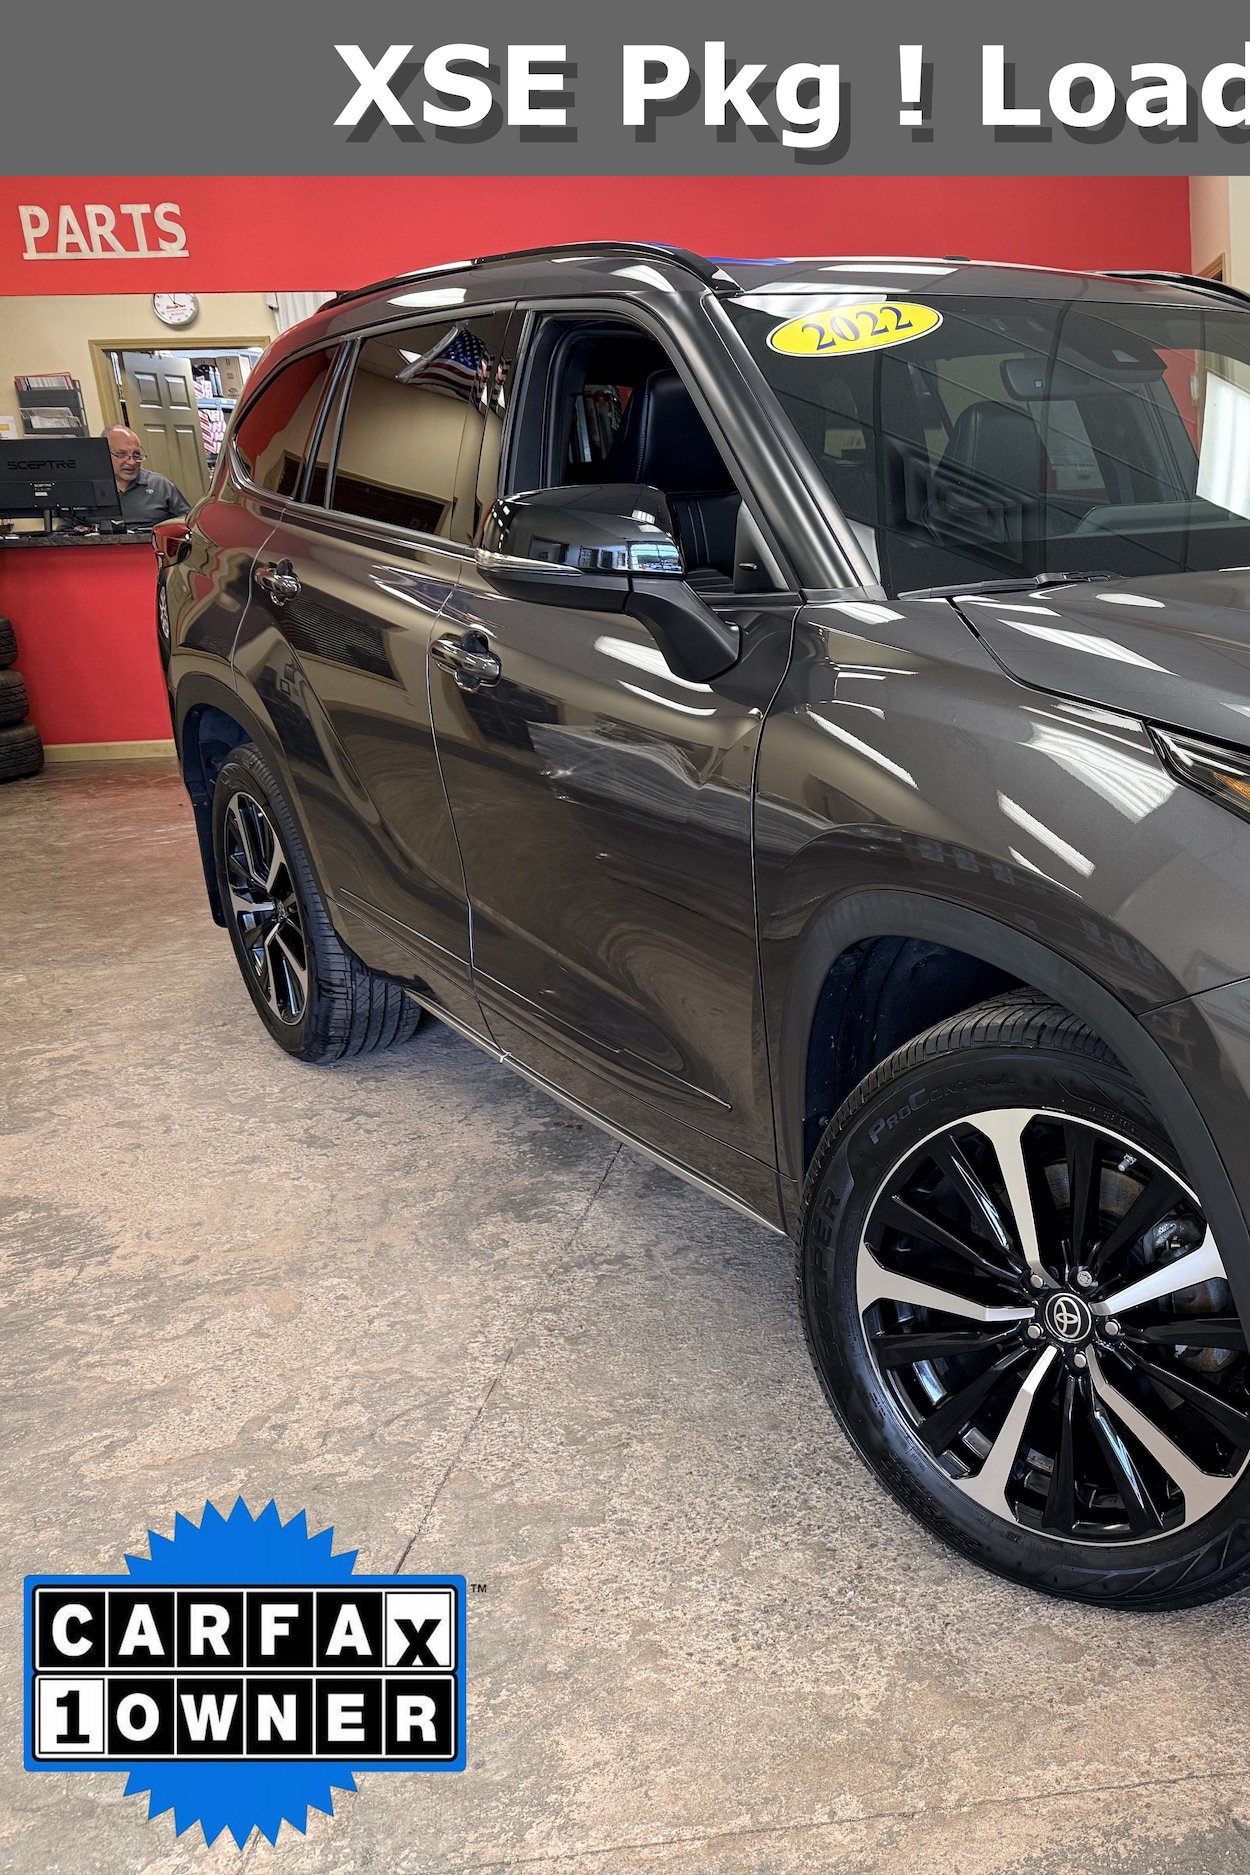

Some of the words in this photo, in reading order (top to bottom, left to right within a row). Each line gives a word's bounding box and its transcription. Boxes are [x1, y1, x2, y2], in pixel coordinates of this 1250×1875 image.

[18, 202, 188, 257] PARTS
[802, 306, 913, 350] 2022
[8, 459, 77, 470] SCEPTRE
